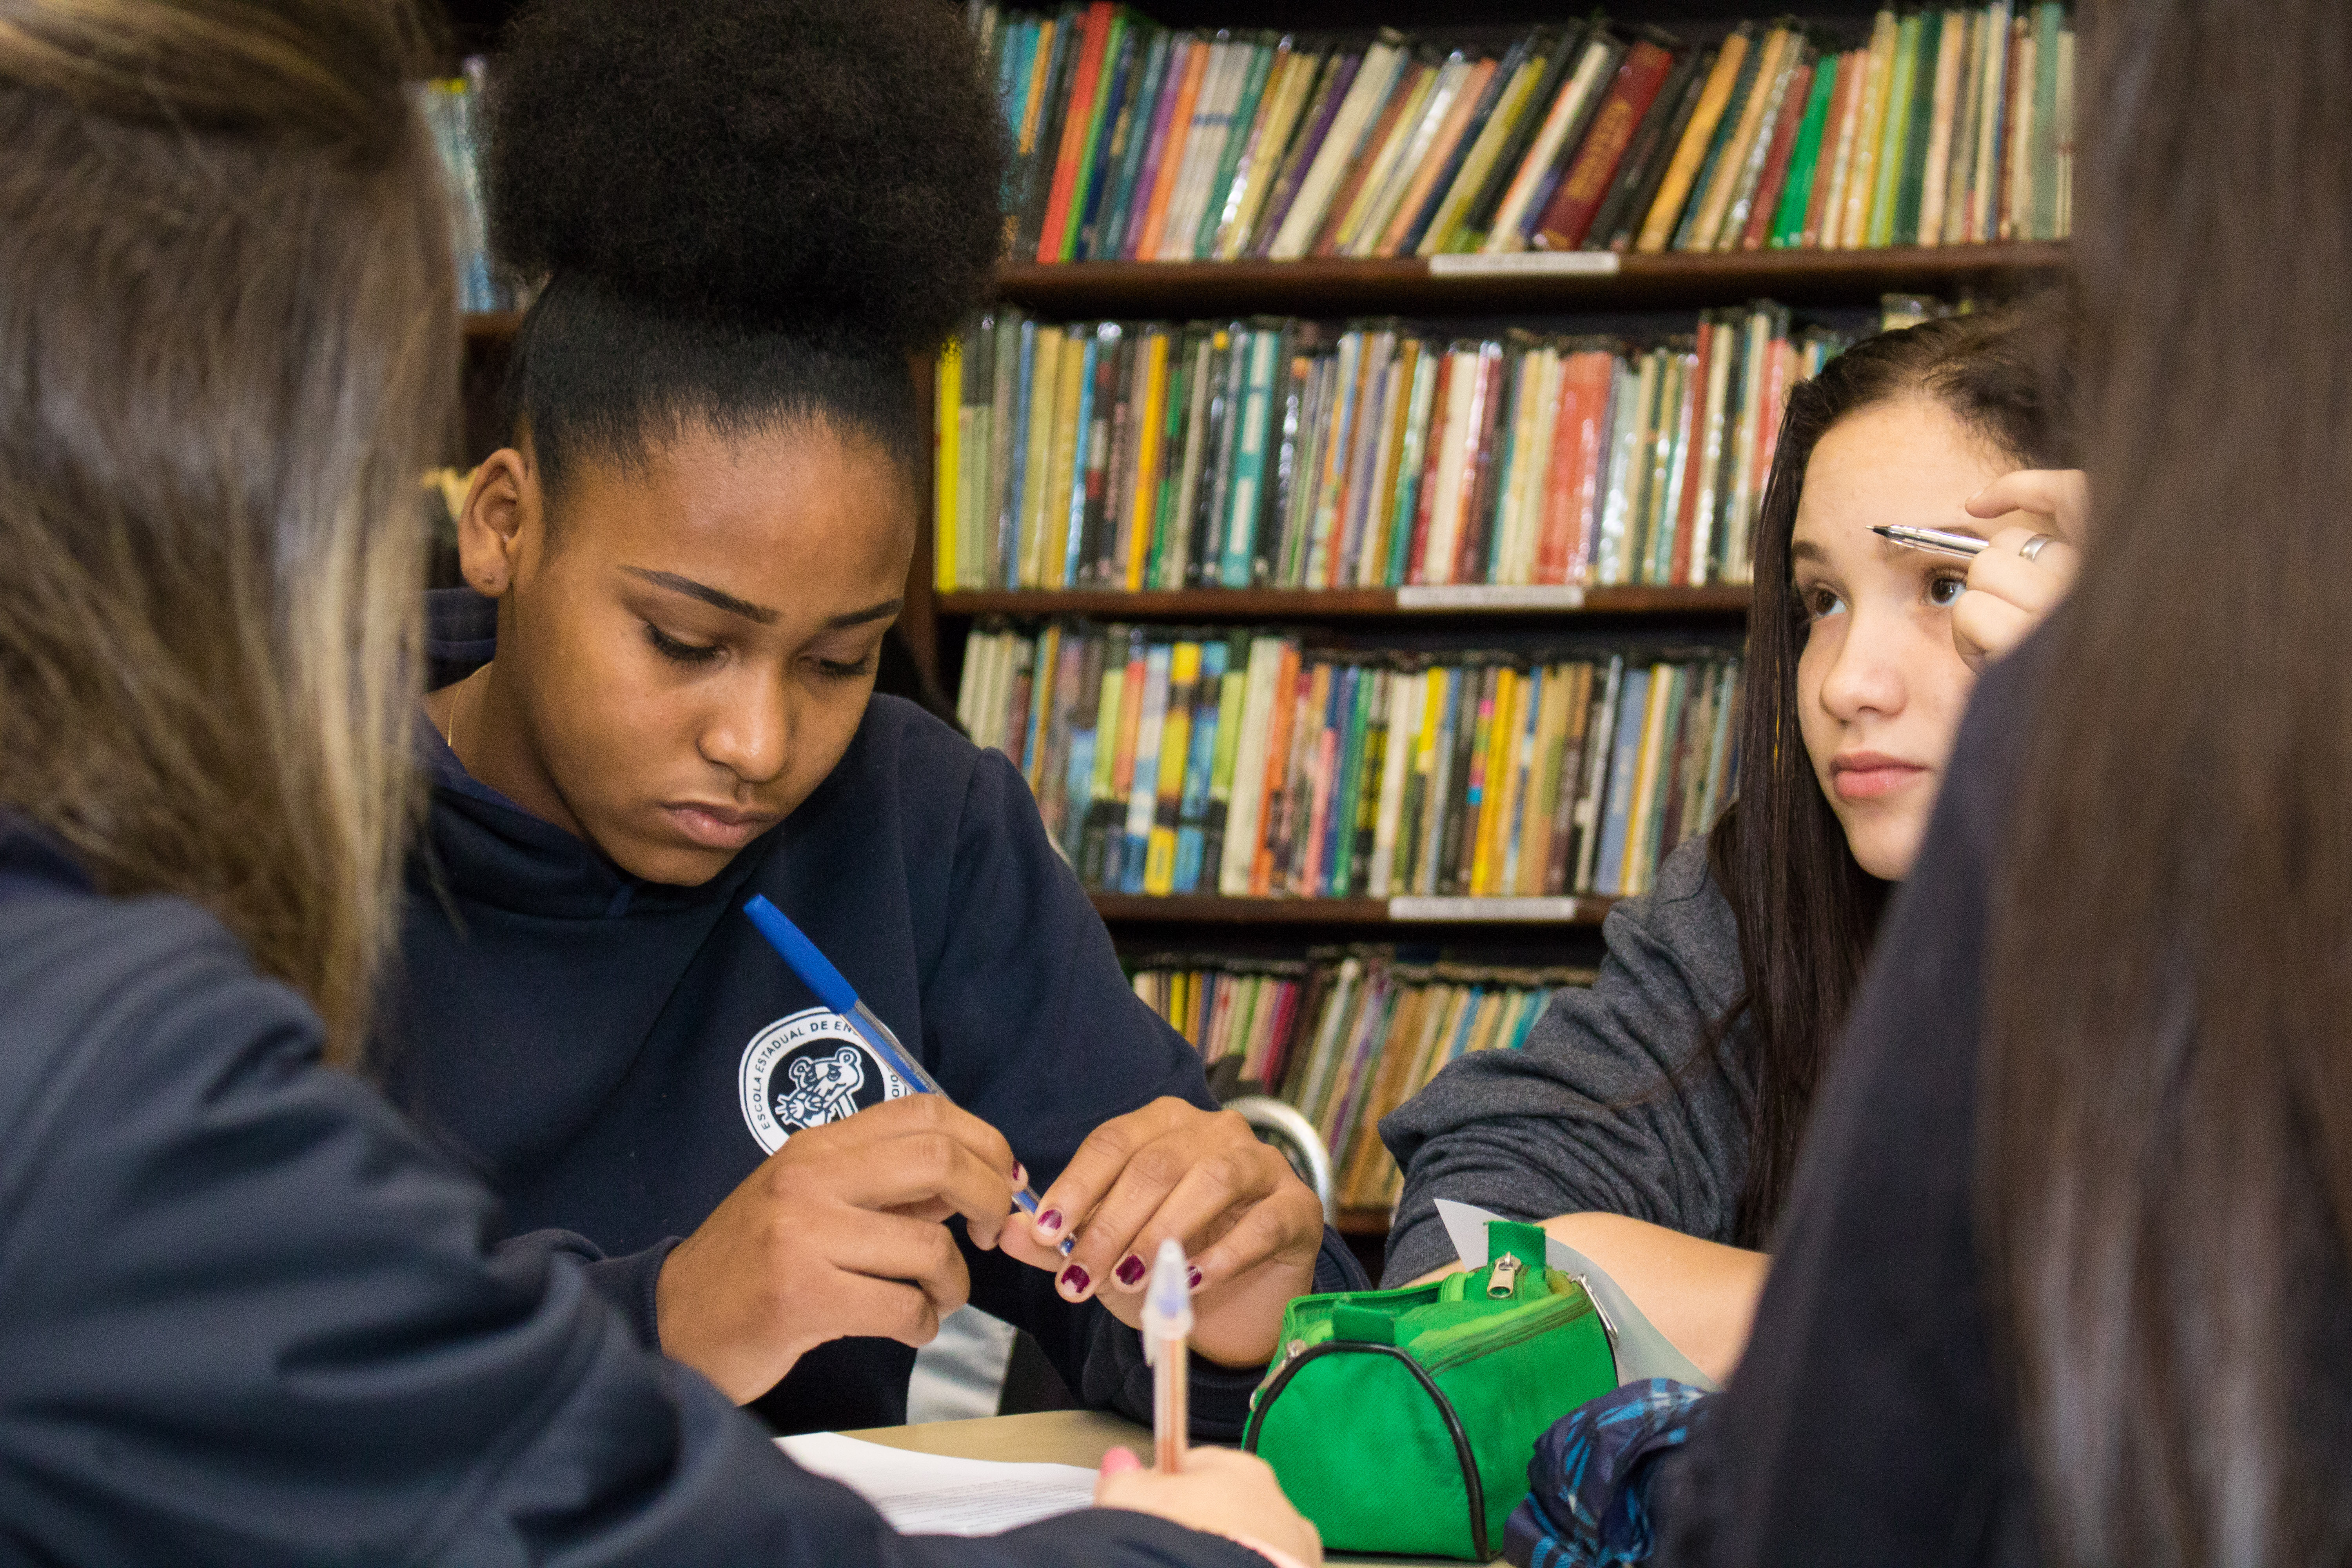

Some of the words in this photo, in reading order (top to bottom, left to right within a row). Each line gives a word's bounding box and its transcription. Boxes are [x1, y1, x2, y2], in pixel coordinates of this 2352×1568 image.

[810, 1021, 828, 1032] DE
[755, 1027, 805, 1073] ESTADUAL
[753, 1077, 770, 1130] ESCOLA
